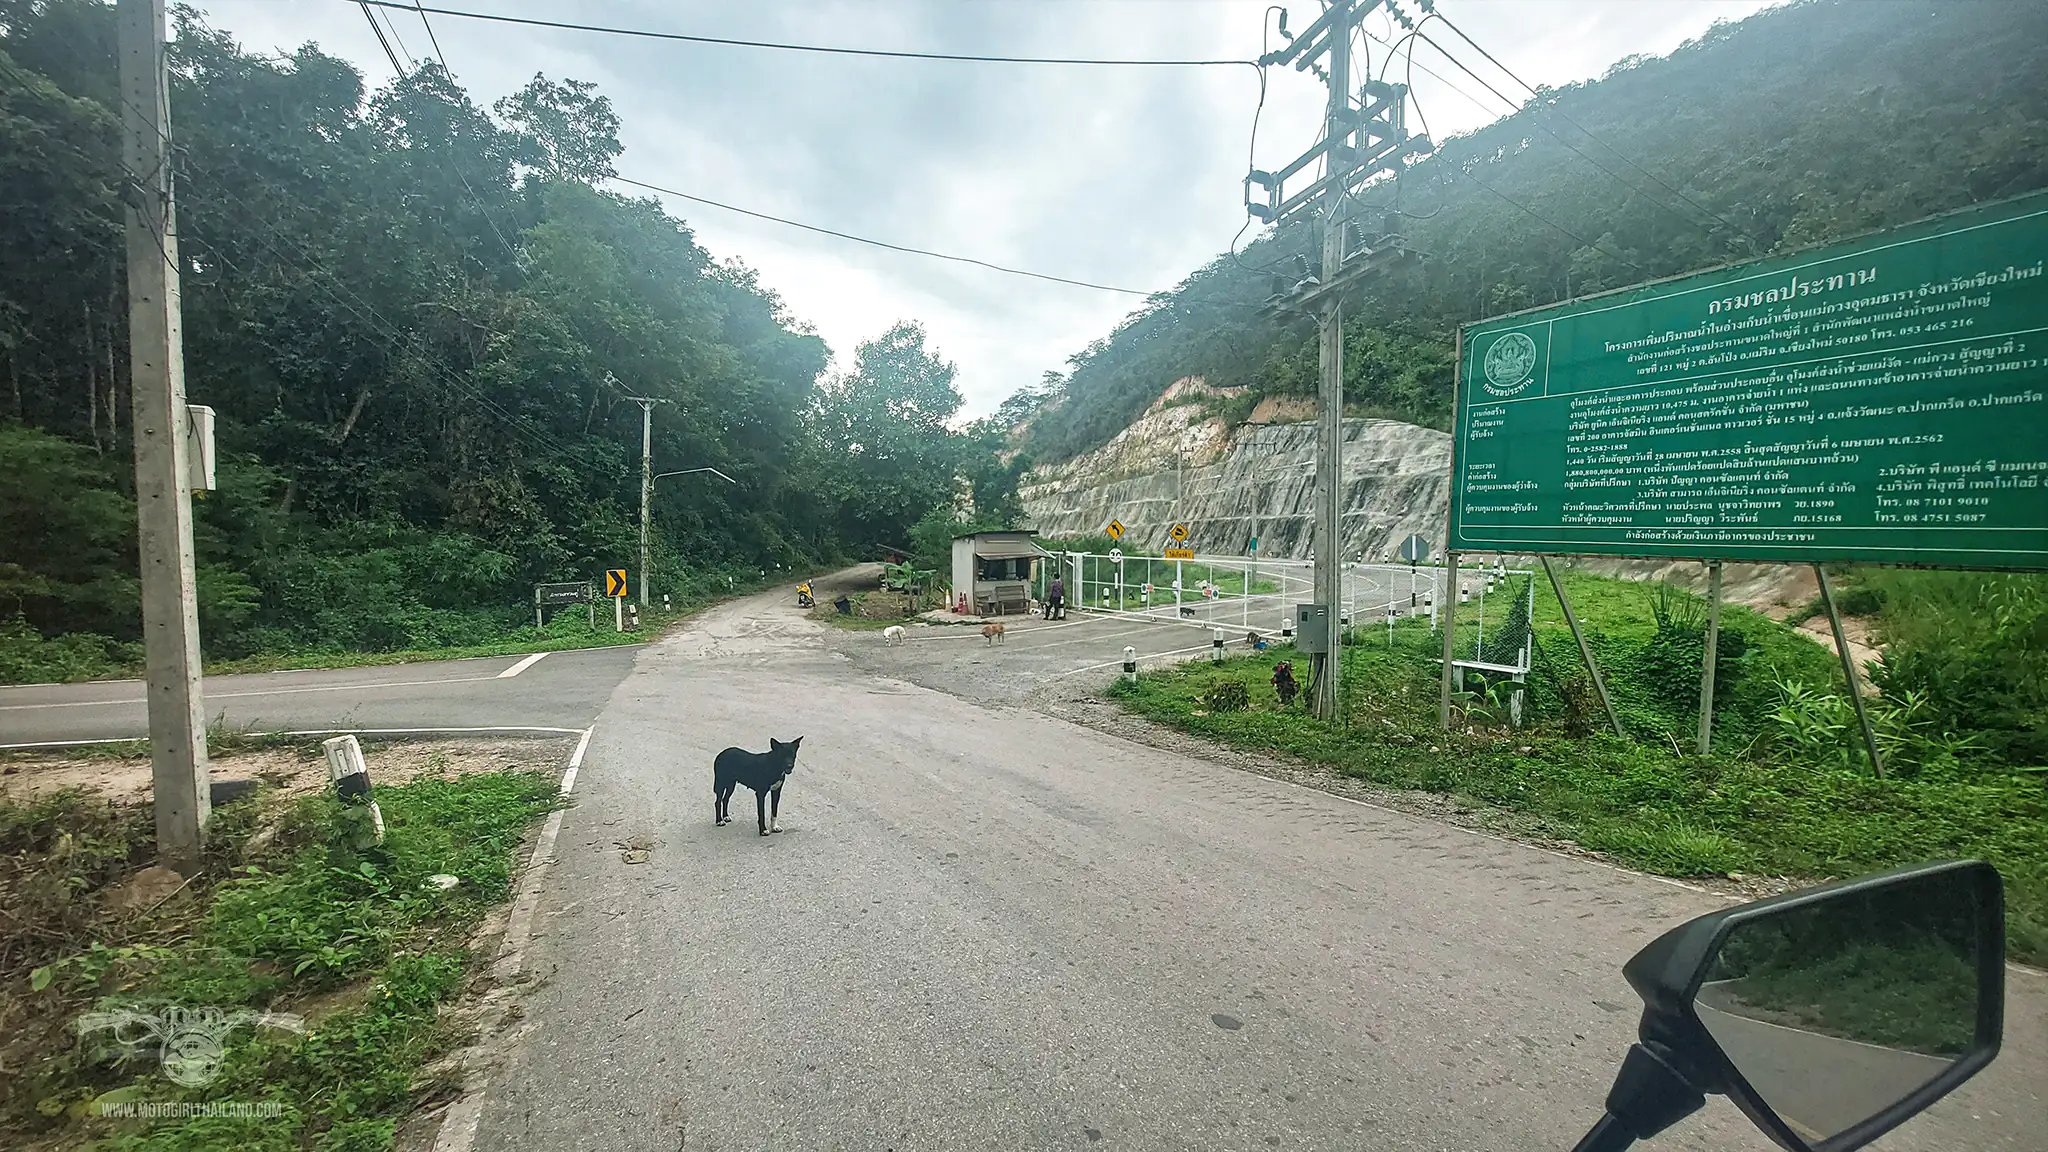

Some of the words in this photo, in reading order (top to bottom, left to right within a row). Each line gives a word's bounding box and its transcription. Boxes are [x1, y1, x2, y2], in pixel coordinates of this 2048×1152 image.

[1708, 265, 1877, 315] กรมชลประทาน
[1917, 260, 2043, 298] จังหวัดเชียงใหม่
[1812, 292, 1992, 333] สำนักพัฒนาแหล่งน้ำขนาดใหญ่
[1659, 363, 1673, 373] 121
[1675, 357, 1690, 371] หมู่
[1691, 360, 1697, 368] 2
[1835, 334, 1868, 346] 50180
[1870, 328, 1896, 341] โทร.
[1900, 326, 1921, 336] 053
[1925, 321, 1947, 333] 465
[1950, 317, 1974, 329] 216
[1958, 337, 2014, 361] สัญญาที่
[2018, 343, 2026, 352] 2
[1787, 382, 1809, 396] แห่ง
[1738, 402, 1763, 415] จำกัด
[1764, 399, 1810, 412] (มหาชน)
[1765, 411, 1781, 425] ชั้น
[1784, 415, 1796, 424] 15
[1799, 410, 1815, 425] หมู่
[1817, 413, 1824, 421] 4
[1968, 390, 2043, 408] อ.ปากเกร็ด
[1587, 455, 1597, 464] วัน
[1666, 451, 1699, 460] เมษายน
[1840, 436, 1885, 449] เมษายน
[1888, 434, 1944, 446] พ.ศ.2562
[1626, 466, 1642, 475] บาท
[1670, 474, 1699, 487] ปัญญา
[1763, 469, 1790, 481] จำกัด
[1878, 463, 1926, 477] 2.บริษัท
[1929, 460, 1941, 474] พี
[1942, 459, 1982, 474] แอนด์
[1827, 481, 1856, 493] จำกัด
[1875, 479, 1923, 492] 4.บริษัท
[1969, 474, 2039, 489] เทคโนโลยี
[1875, 495, 1903, 507] โทร.
[1905, 498, 1921, 507] 08
[1924, 497, 1953, 507] 7101
[1957, 497, 1989, 506] 9010
[1665, 512, 1715, 525] นายปริญญา
[1874, 510, 1900, 523] โทร.
[1903, 513, 1918, 523] 08
[1920, 513, 1950, 523] 4751
[1954, 513, 1987, 523] 5087
[1625, 529, 1815, 542] กำลังก่อสร้างด้วยเงินภาษีอากรของประชาชน
